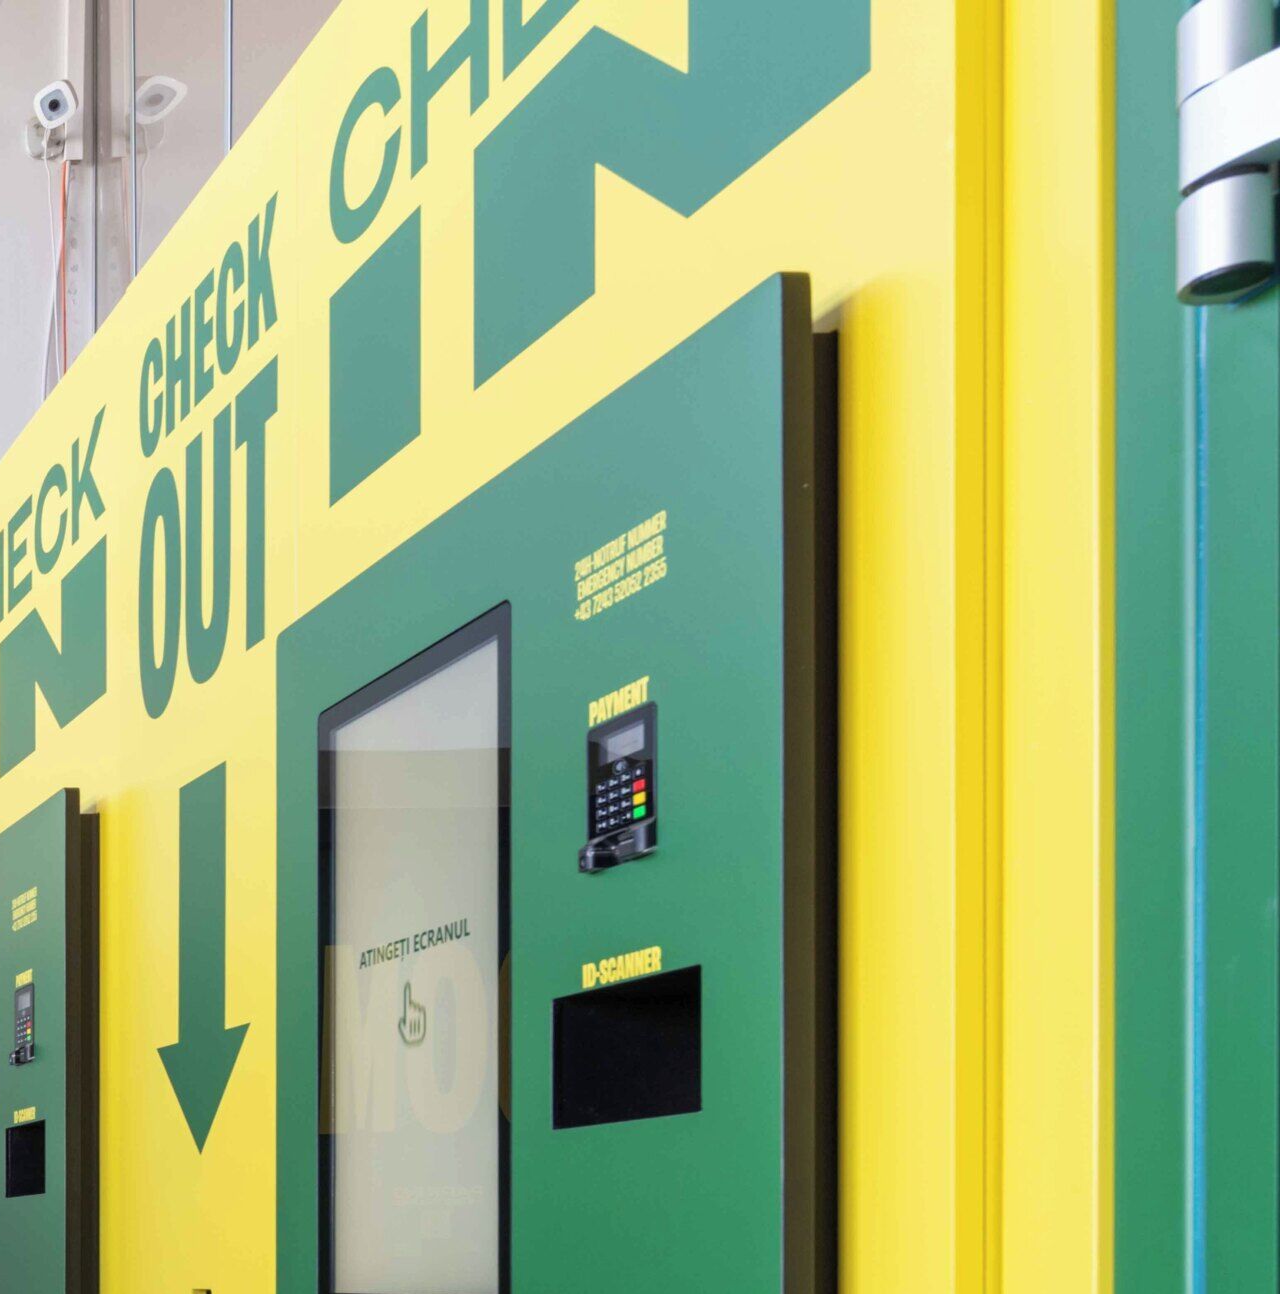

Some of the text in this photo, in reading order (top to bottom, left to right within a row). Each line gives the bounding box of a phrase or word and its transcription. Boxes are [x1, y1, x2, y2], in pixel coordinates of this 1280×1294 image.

[138, 190, 279, 459] CHECK
[137, 354, 279, 720] OUT
[627, 510, 667, 550] NUMMER
[577, 535, 664, 601] EMERGENCY NUMBER
[589, 675, 650, 728] PAYMENT
[413, 918, 470, 954] ECRANUL
[582, 946, 662, 989] ID-SCANNER
